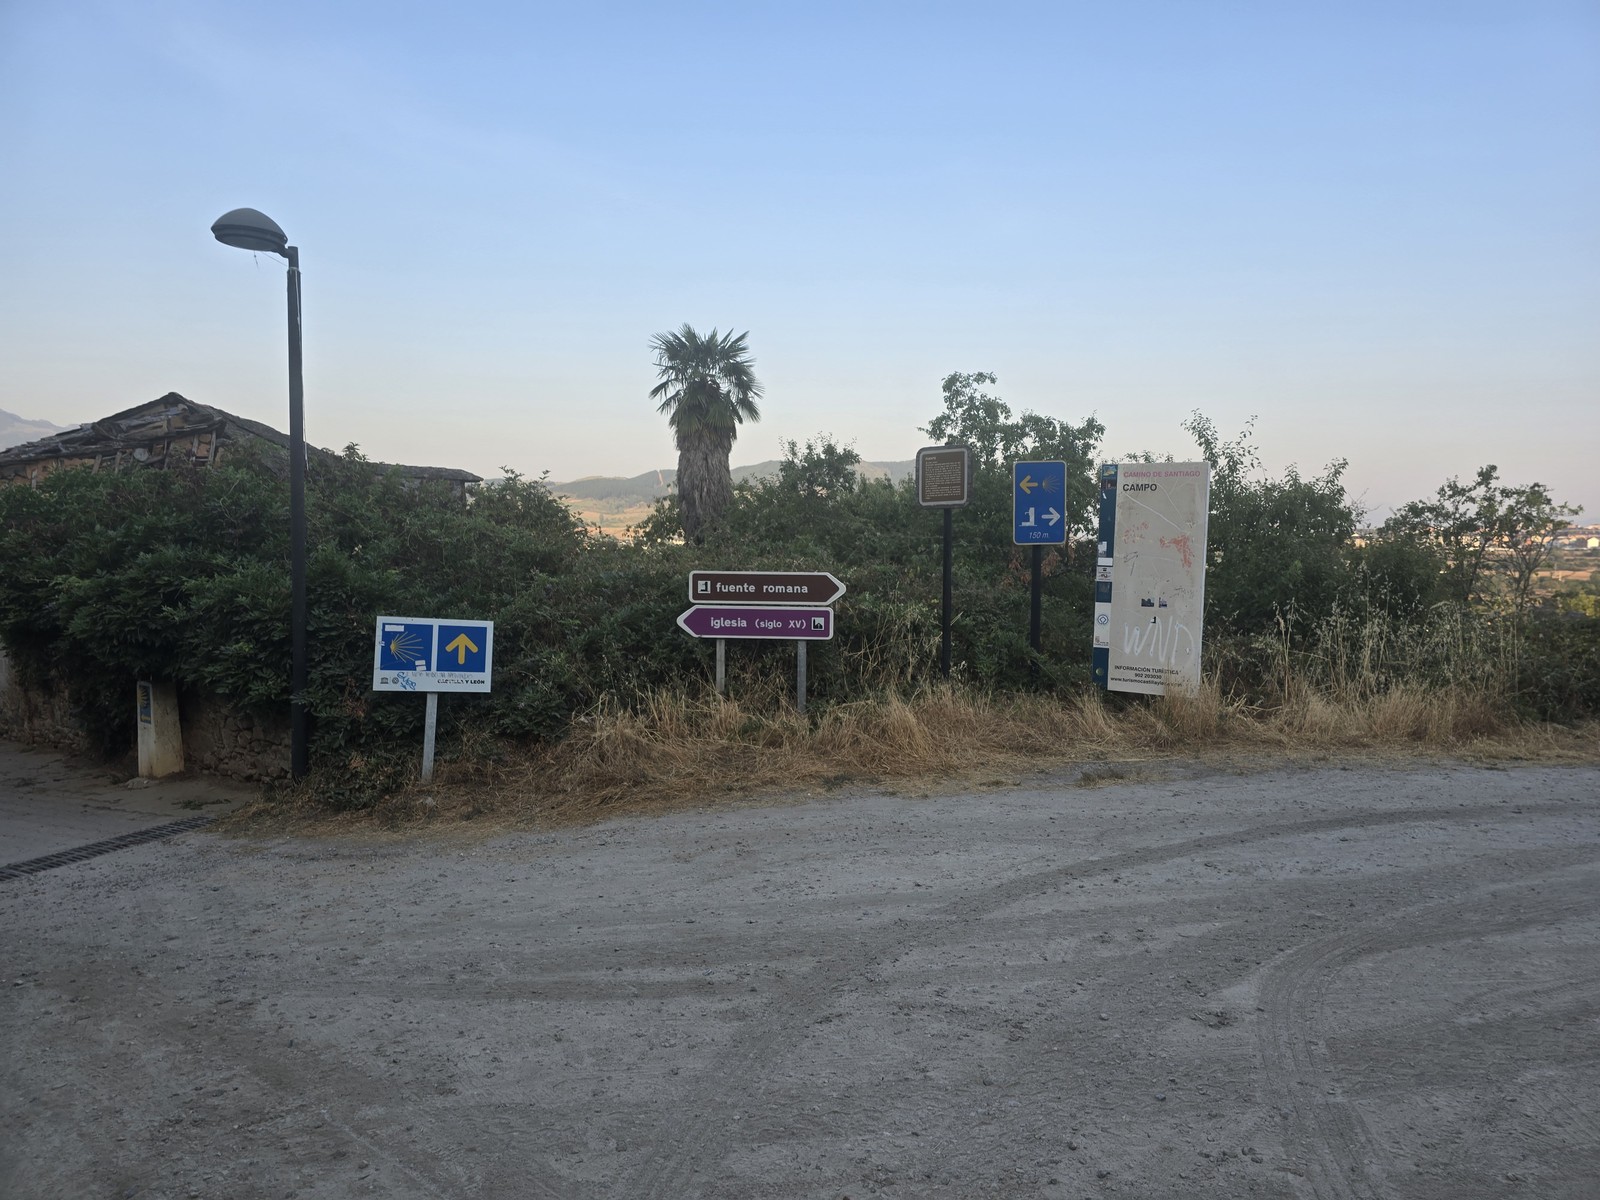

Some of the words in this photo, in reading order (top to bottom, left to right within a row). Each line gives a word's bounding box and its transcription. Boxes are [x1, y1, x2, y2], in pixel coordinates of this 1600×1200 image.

[1164, 470, 1200, 478] SANTIAGO
[1122, 483, 1158, 492] CAMPO
[1029, 531, 1042, 539] 150
[716, 582, 756, 593] fuente
[763, 583, 809, 594] romana
[710, 616, 747, 629] iglesia
[755, 618, 782, 630] (siglo
[788, 619, 807, 630] XV)
[1114, 665, 1151, 673] INFORMACIÓN
